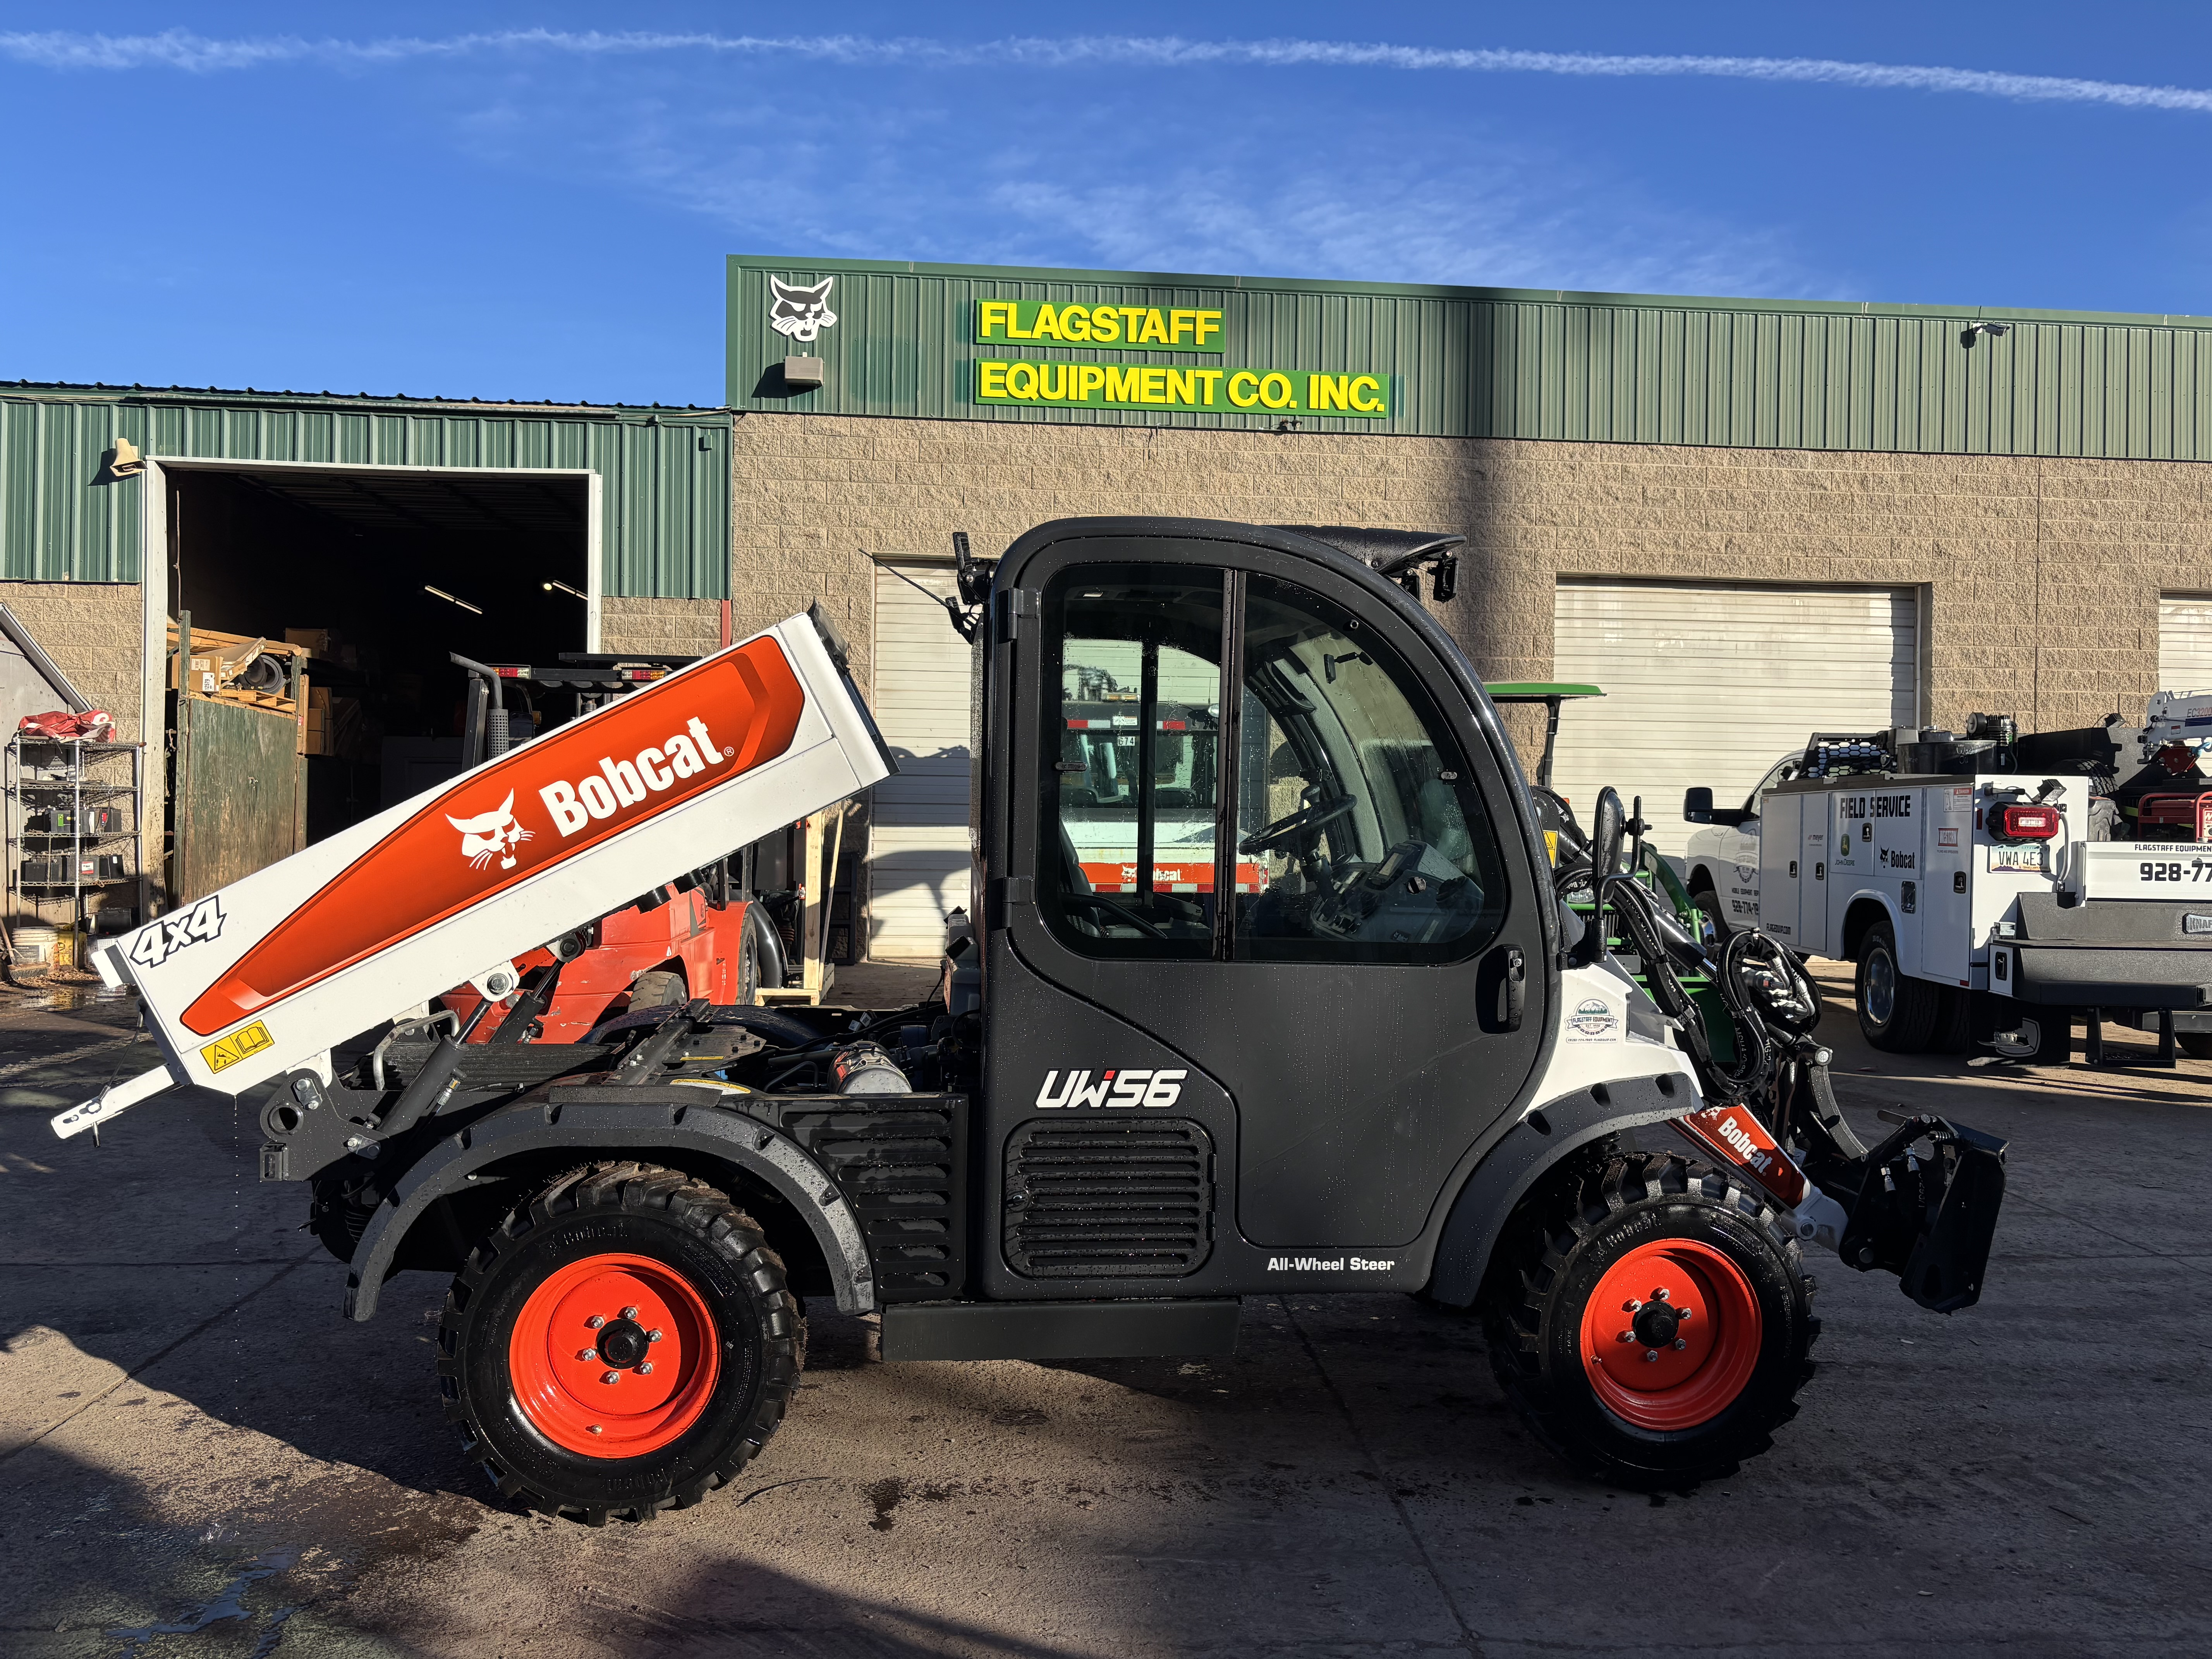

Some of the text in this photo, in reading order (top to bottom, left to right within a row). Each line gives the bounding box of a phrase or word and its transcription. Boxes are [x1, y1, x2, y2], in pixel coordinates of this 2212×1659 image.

[981, 301, 1222, 345] FLAGSTAFF
[981, 362, 1386, 412] EQUIPMENT CO. INC.
[2187, 707, 2212, 717] EC3200
[1956, 746, 1978, 755] Waste
[1960, 756, 1968, 764] Oil
[538, 716, 725, 837] Bobcat
[1840, 795, 1910, 819] FIELD SERVICE
[1891, 850, 1915, 869] Bobcat
[1999, 851, 2044, 866] VWA 4E3
[2140, 863, 2212, 882] 928-77
[130, 895, 227, 968] 4x4
[1717, 1115, 1773, 1174] Bobcat
[1267, 1257, 1395, 1271] All-Wheel Steer
